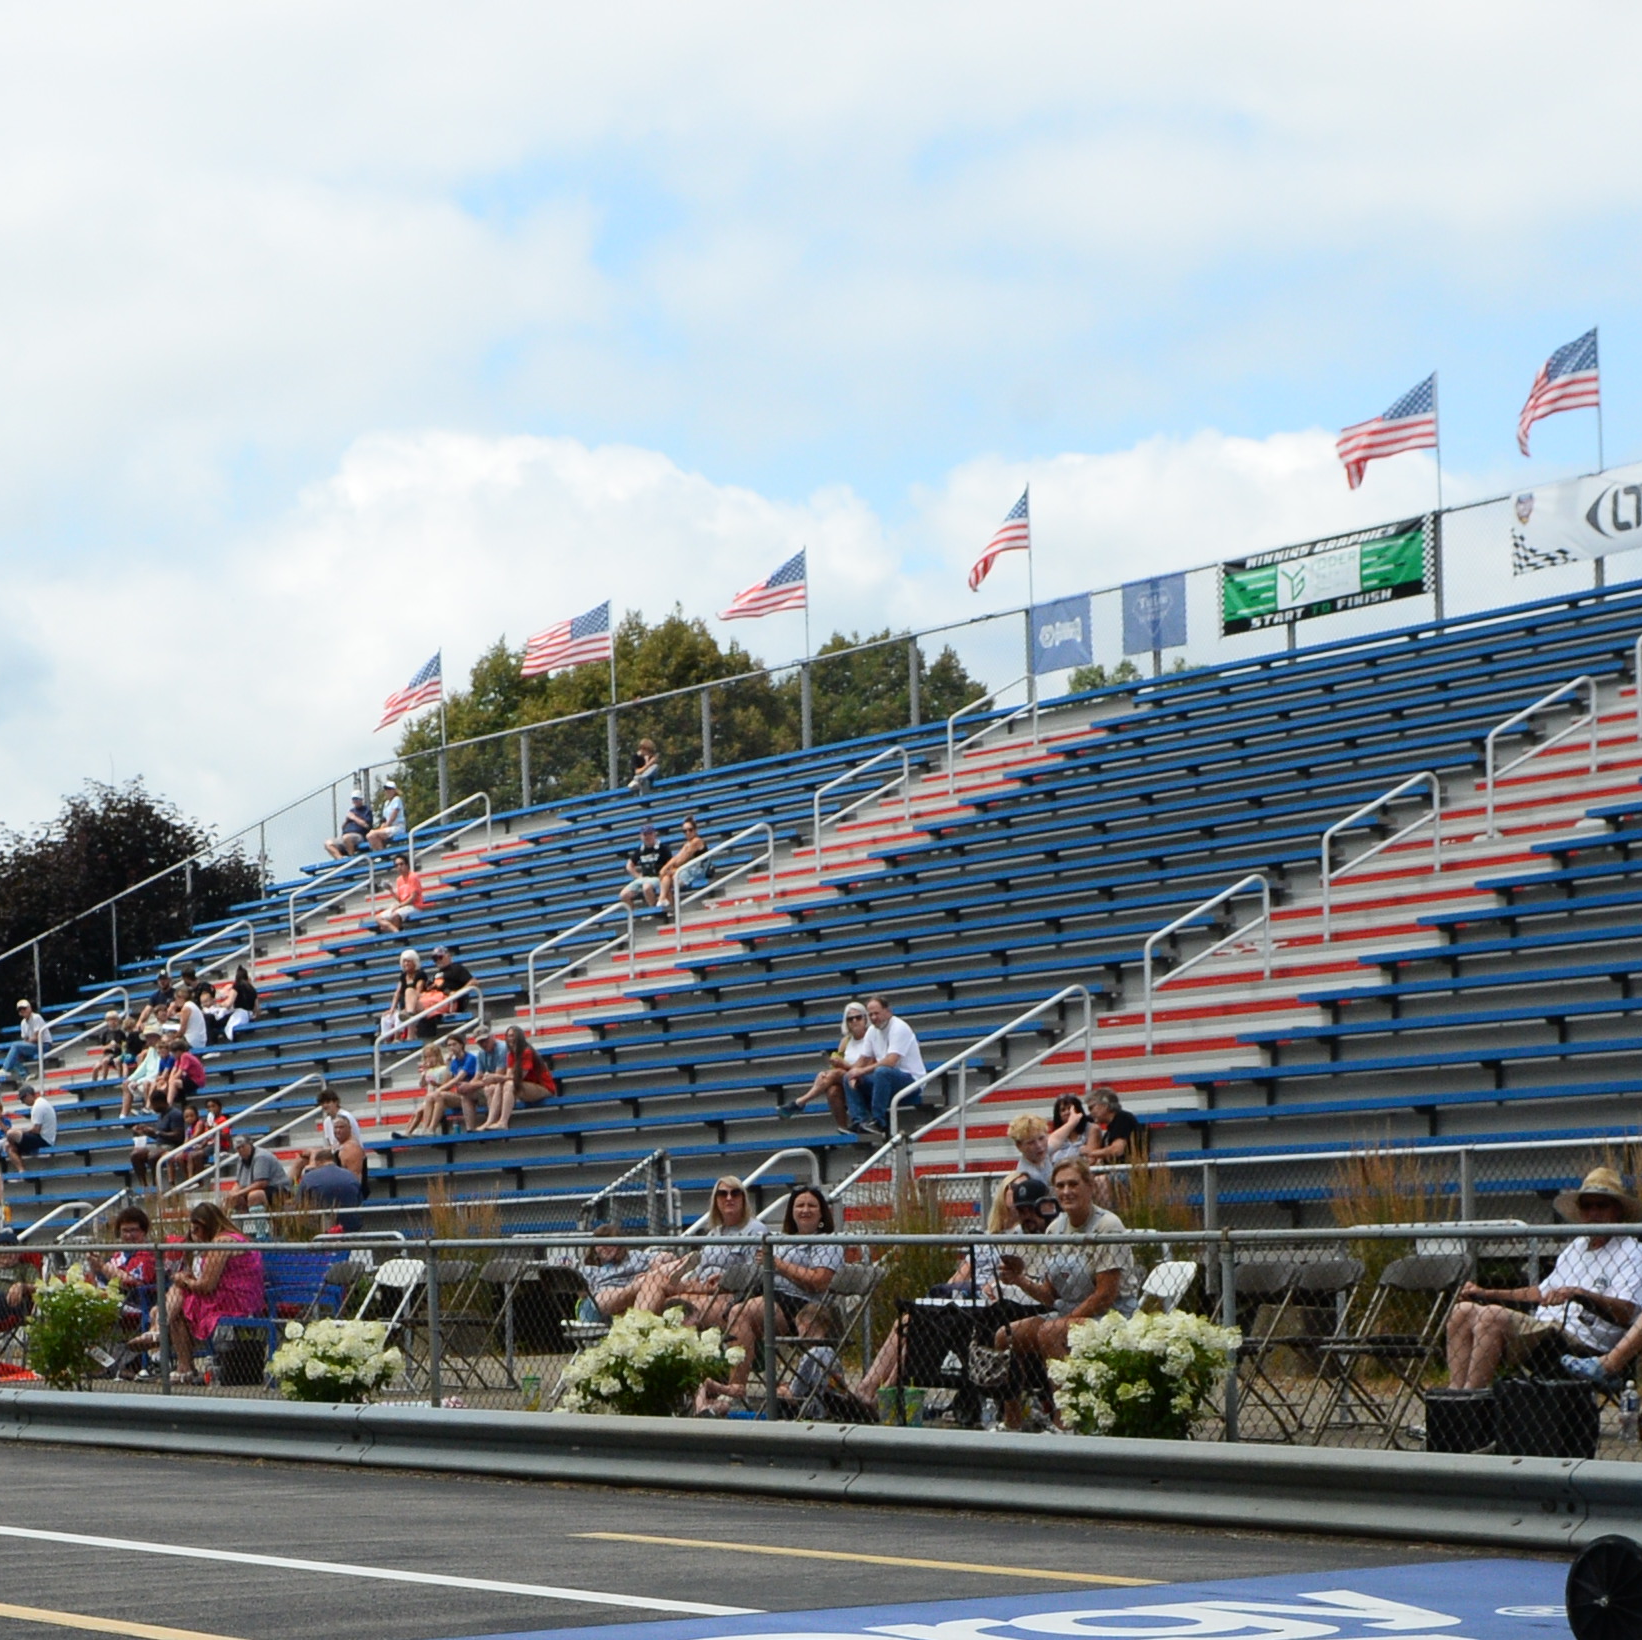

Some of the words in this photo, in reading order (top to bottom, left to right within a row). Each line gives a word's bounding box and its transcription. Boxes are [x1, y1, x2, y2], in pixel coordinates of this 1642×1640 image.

[1312, 524, 1400, 554] GRAPHICS
[1313, 551, 1358, 572] ODER
[1249, 607, 1305, 630] START
[1311, 603, 1333, 616] TO
[1335, 588, 1394, 610] FINISH
